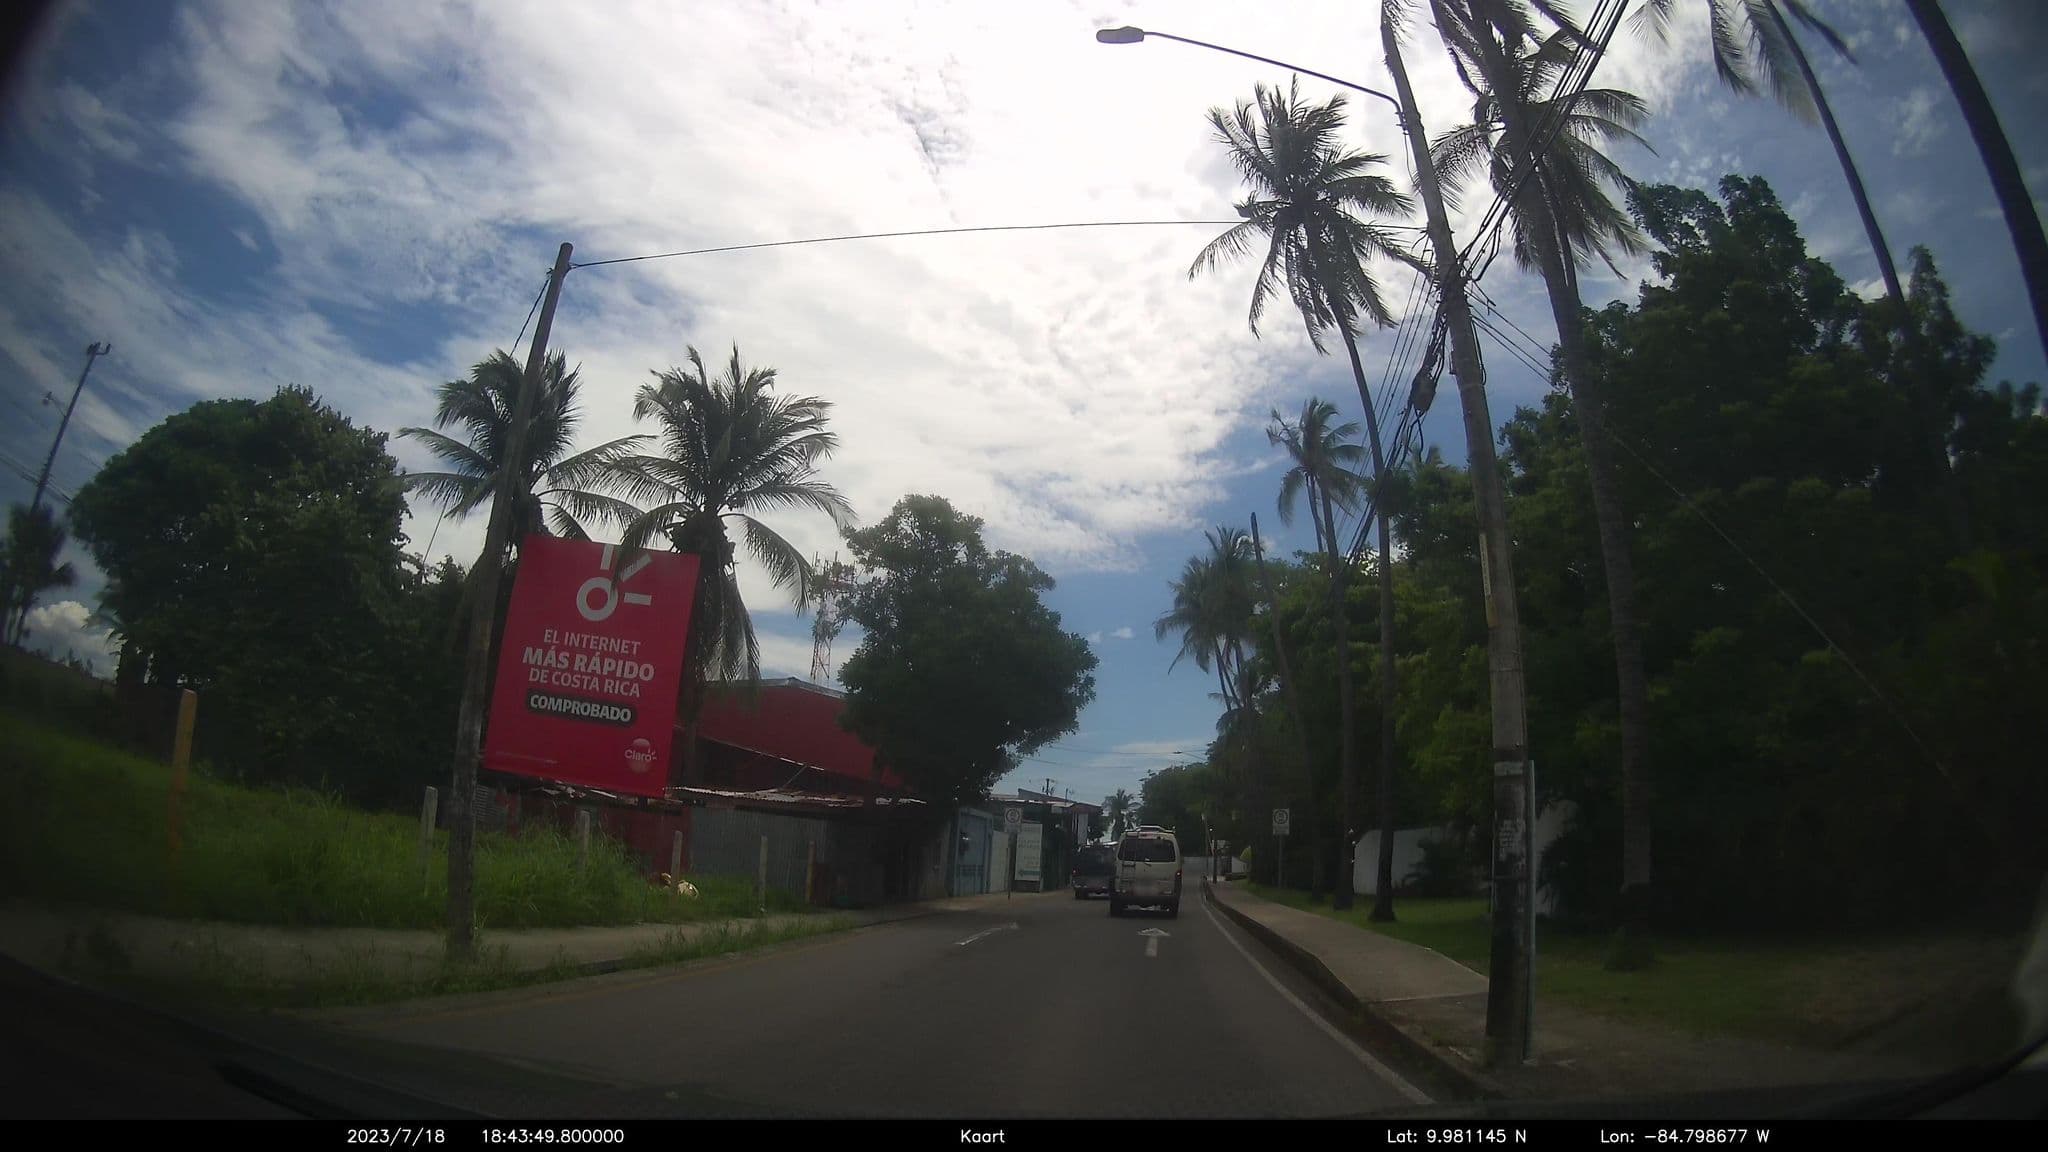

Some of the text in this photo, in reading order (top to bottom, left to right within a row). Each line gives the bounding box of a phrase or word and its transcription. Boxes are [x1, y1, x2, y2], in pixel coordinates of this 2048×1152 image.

[544, 629, 641, 656] EL INTERNET
[523, 646, 655, 681] MÁS RÁPIDO
[528, 669, 641, 697] DE COSTA RICA
[530, 694, 632, 722] COMPROBADO
[624, 748, 652, 762] Claro
